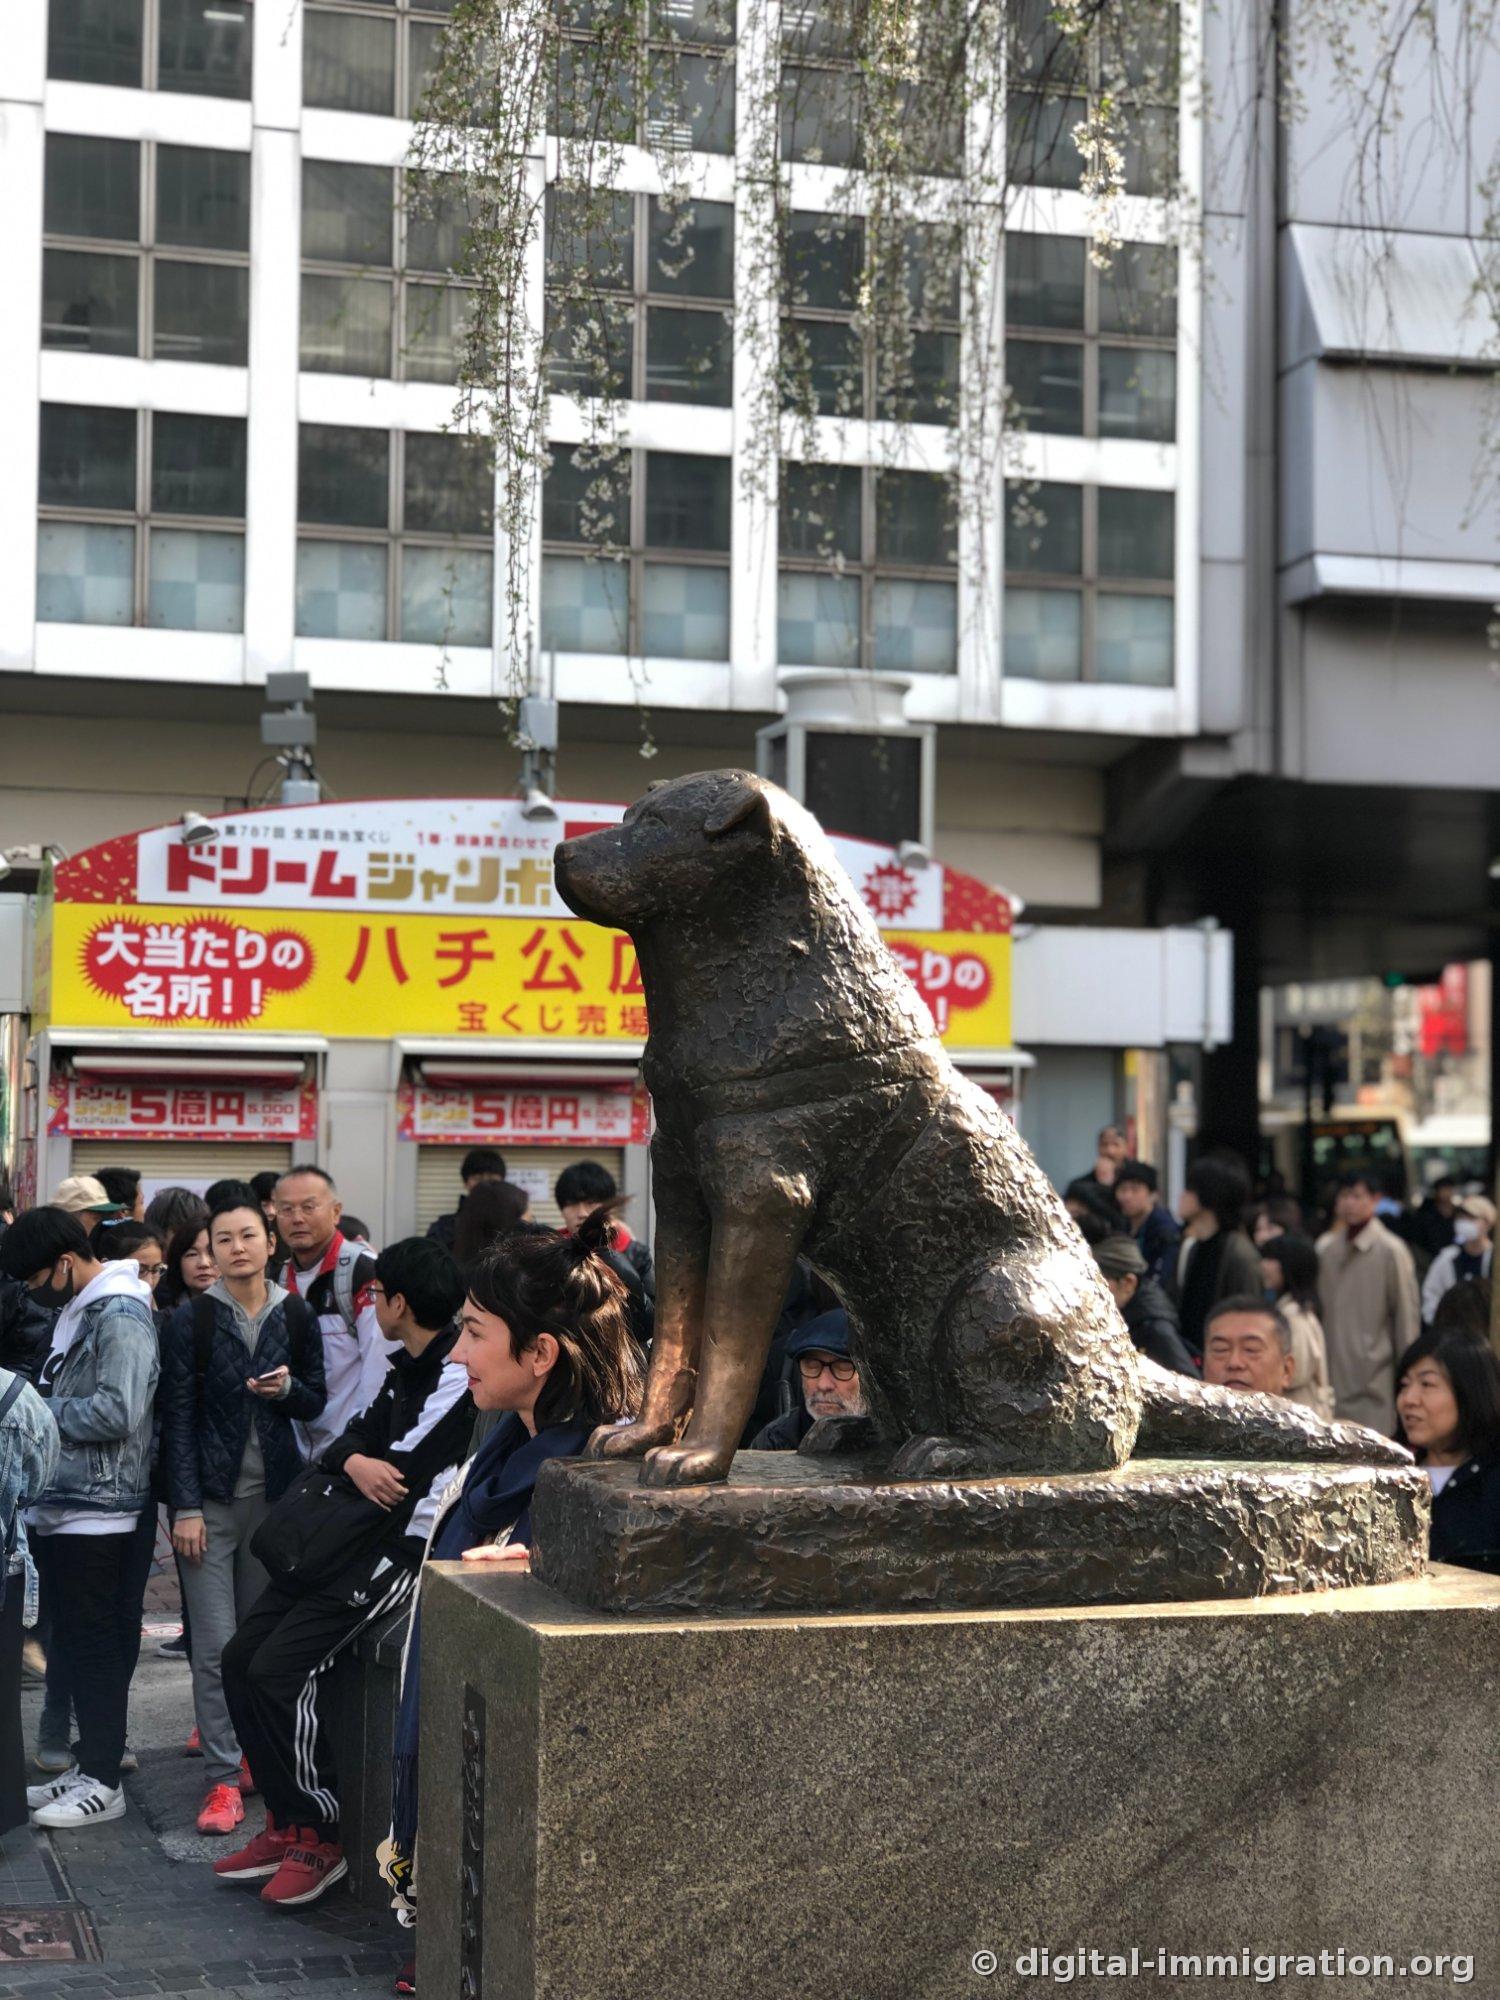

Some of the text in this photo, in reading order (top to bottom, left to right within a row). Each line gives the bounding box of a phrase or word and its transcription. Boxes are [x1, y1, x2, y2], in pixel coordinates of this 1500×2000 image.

[97, 923, 304, 970] 大当たりの
[123, 973, 263, 1017] 名所!!
[458, 1002, 649, 1036] 宝くじ売場
[130, 1089, 245, 1126] 5億円
